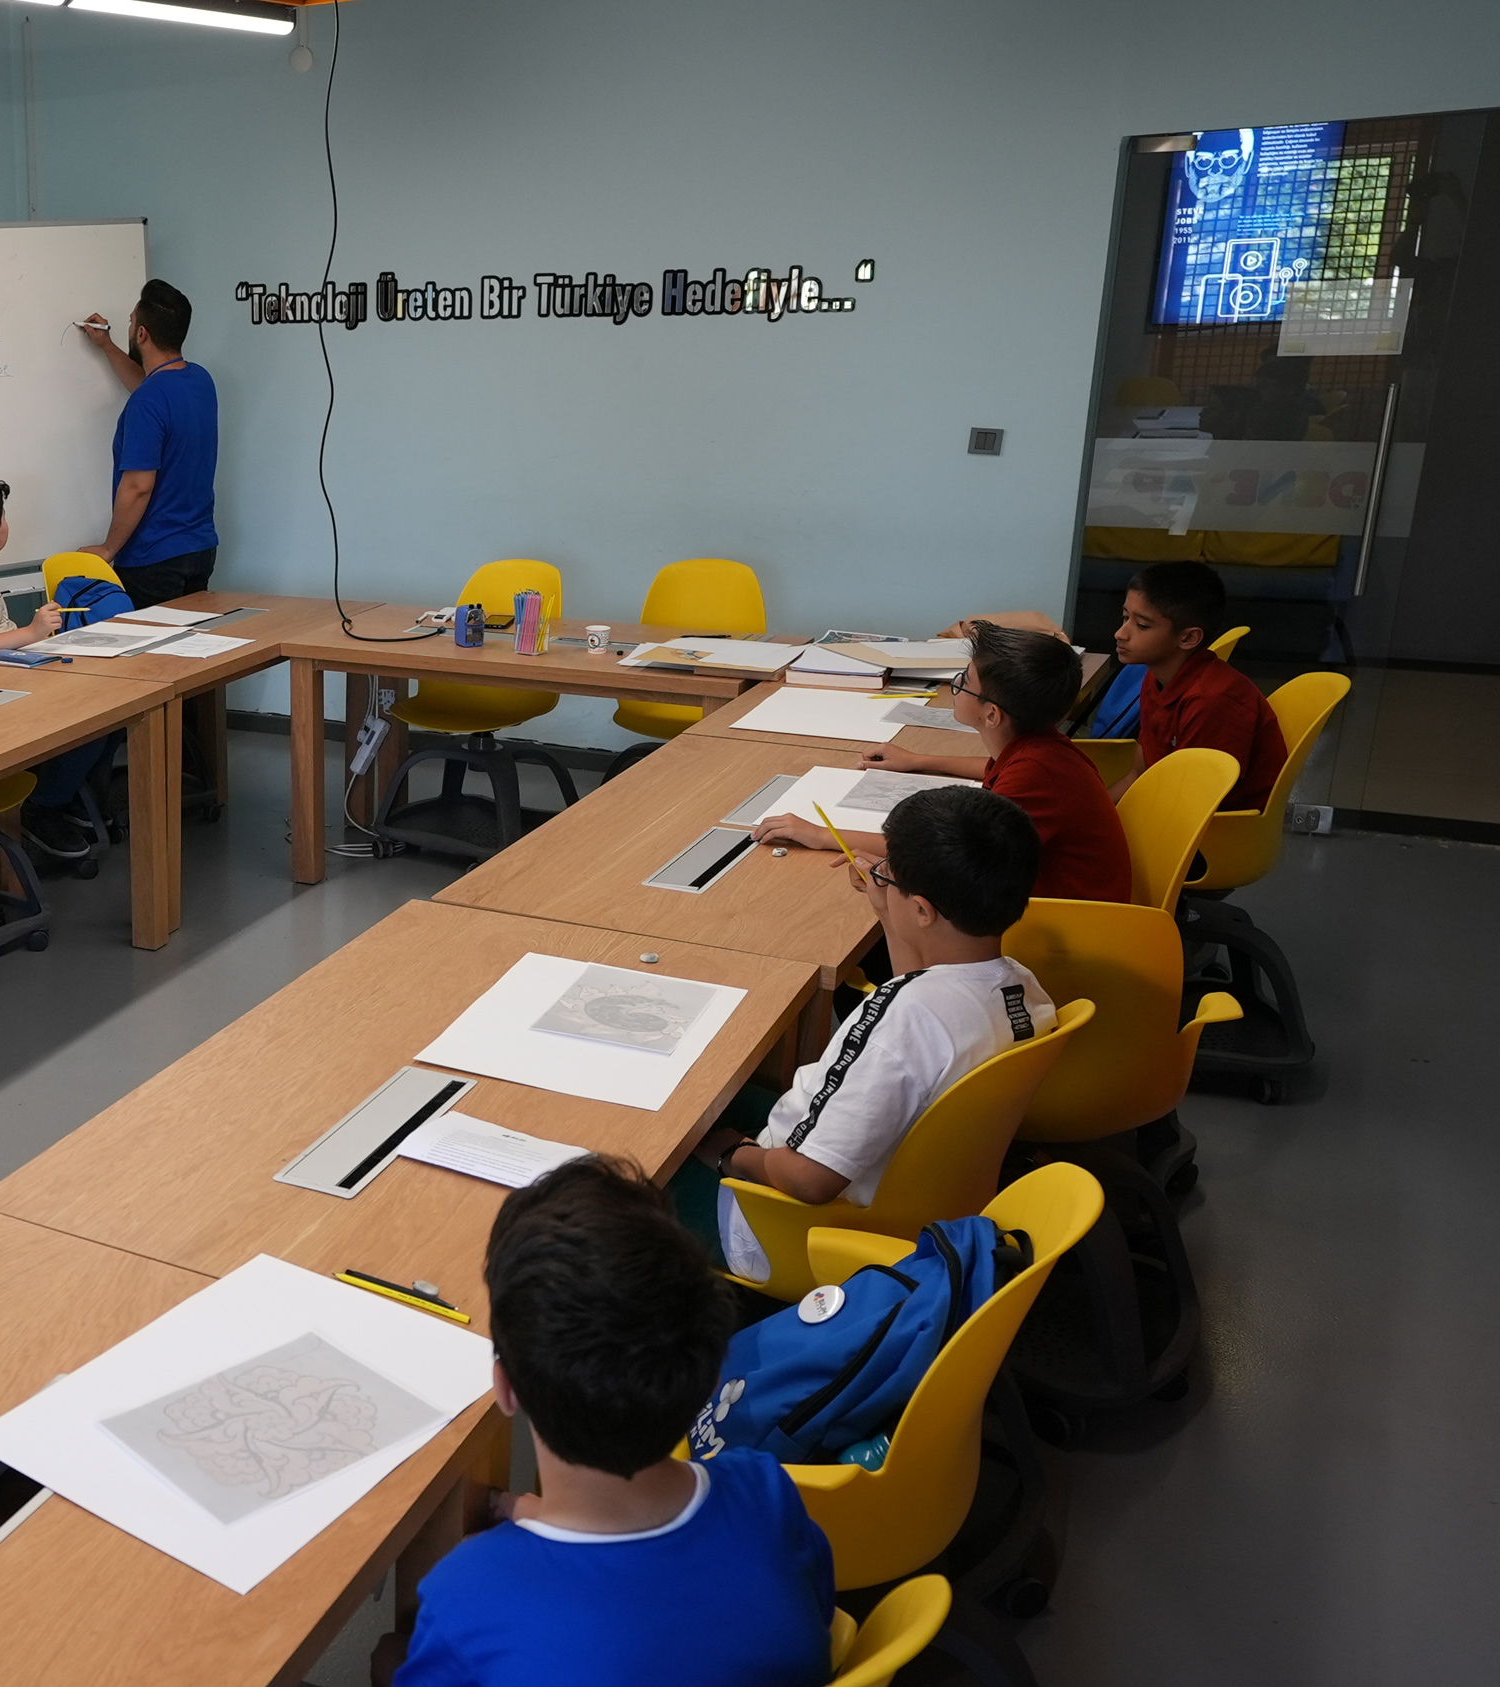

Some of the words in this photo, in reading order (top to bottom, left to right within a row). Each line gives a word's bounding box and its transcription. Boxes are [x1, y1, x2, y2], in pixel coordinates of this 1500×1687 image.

[1176, 207, 1204, 216] STEVE
[1175, 217, 1198, 225] JOBS
[1174, 227, 1193, 235] 1955
[1172, 236, 1191, 244] 2011
[376, 272, 472, 322] Üreten
[480, 275, 526, 320] Bir
[534, 271, 654, 326] Türkiye
[848, 994, 887, 1045] OVERCOME
[835, 1048, 856, 1072] YOUR
[813, 1075, 839, 1106] LIMITS
